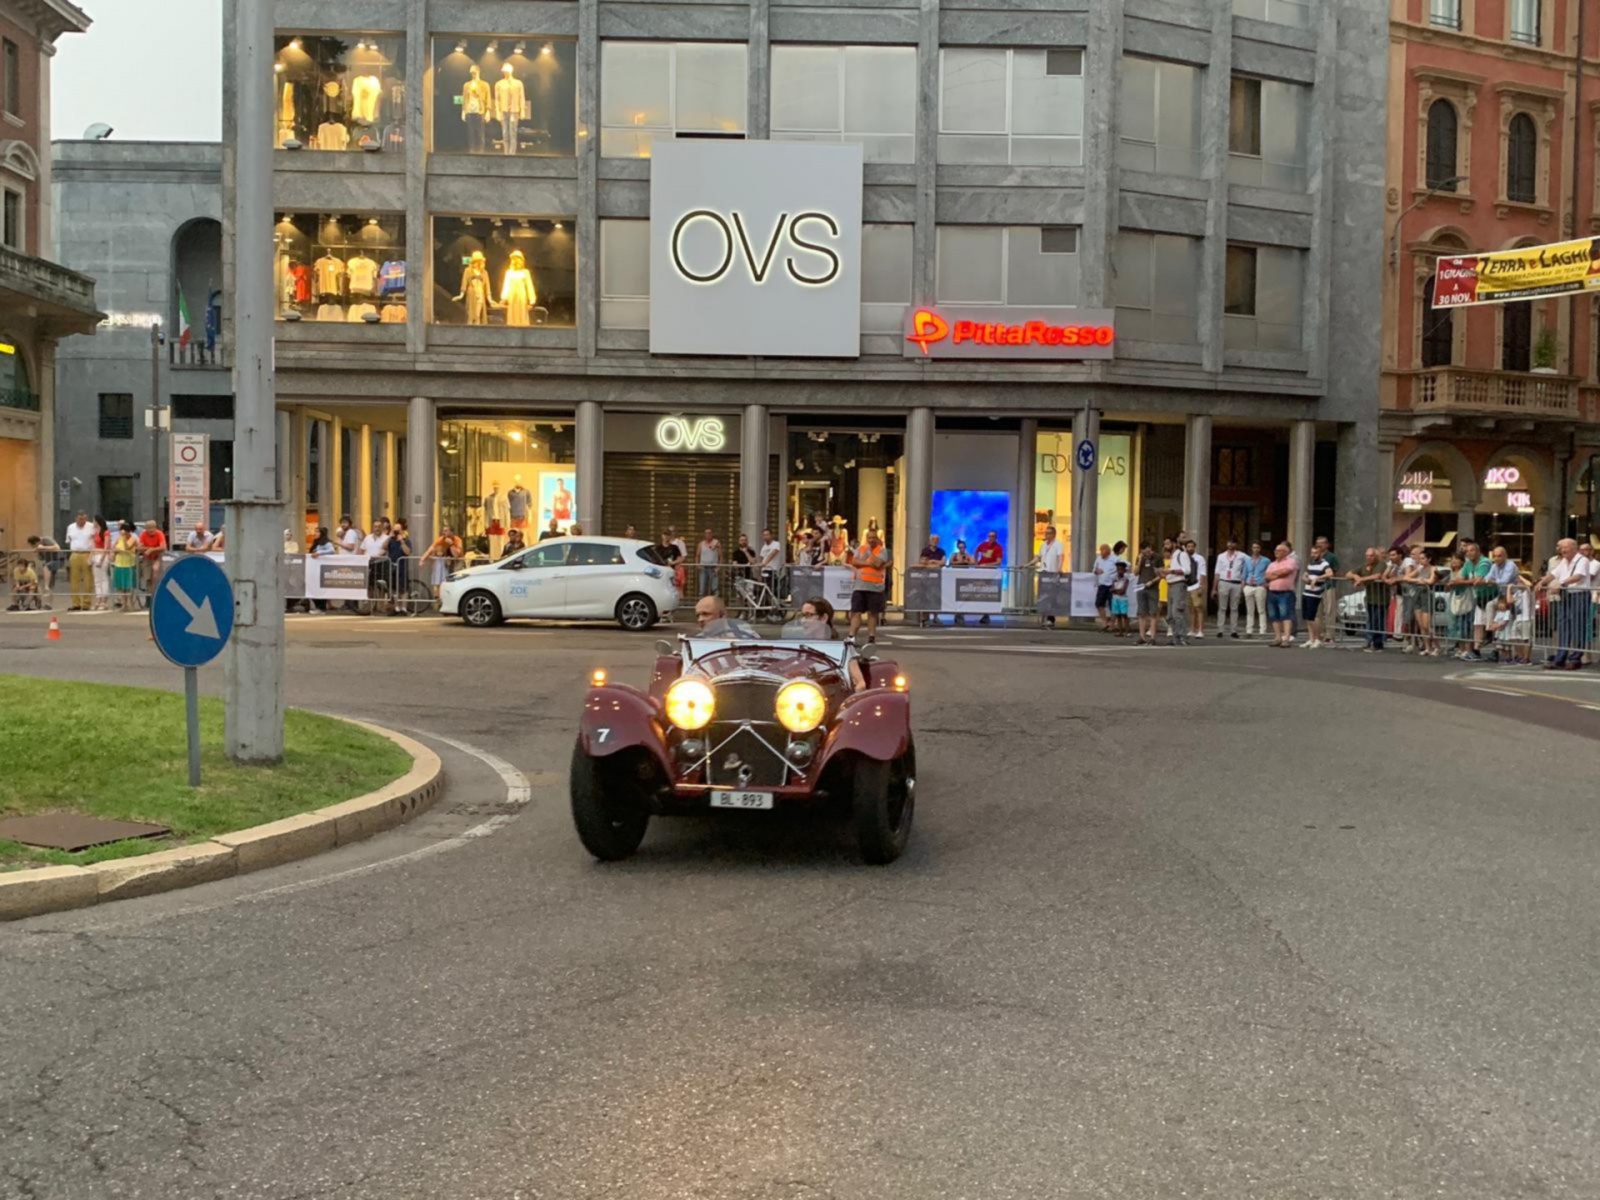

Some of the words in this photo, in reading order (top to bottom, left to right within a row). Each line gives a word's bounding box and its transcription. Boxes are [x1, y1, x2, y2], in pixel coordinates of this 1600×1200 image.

[671, 209, 840, 285] OVS
[1479, 257, 1526, 275] TERRA
[1529, 259, 1538, 269] e
[1539, 249, 1590, 268] LAGHI
[1439, 295, 1450, 305] 30
[953, 319, 1115, 347] PittaRosso
[656, 416, 725, 450] OVS
[597, 728, 611, 743] 7
[720, 792, 735, 806] BL
[741, 793, 763, 807] 893
